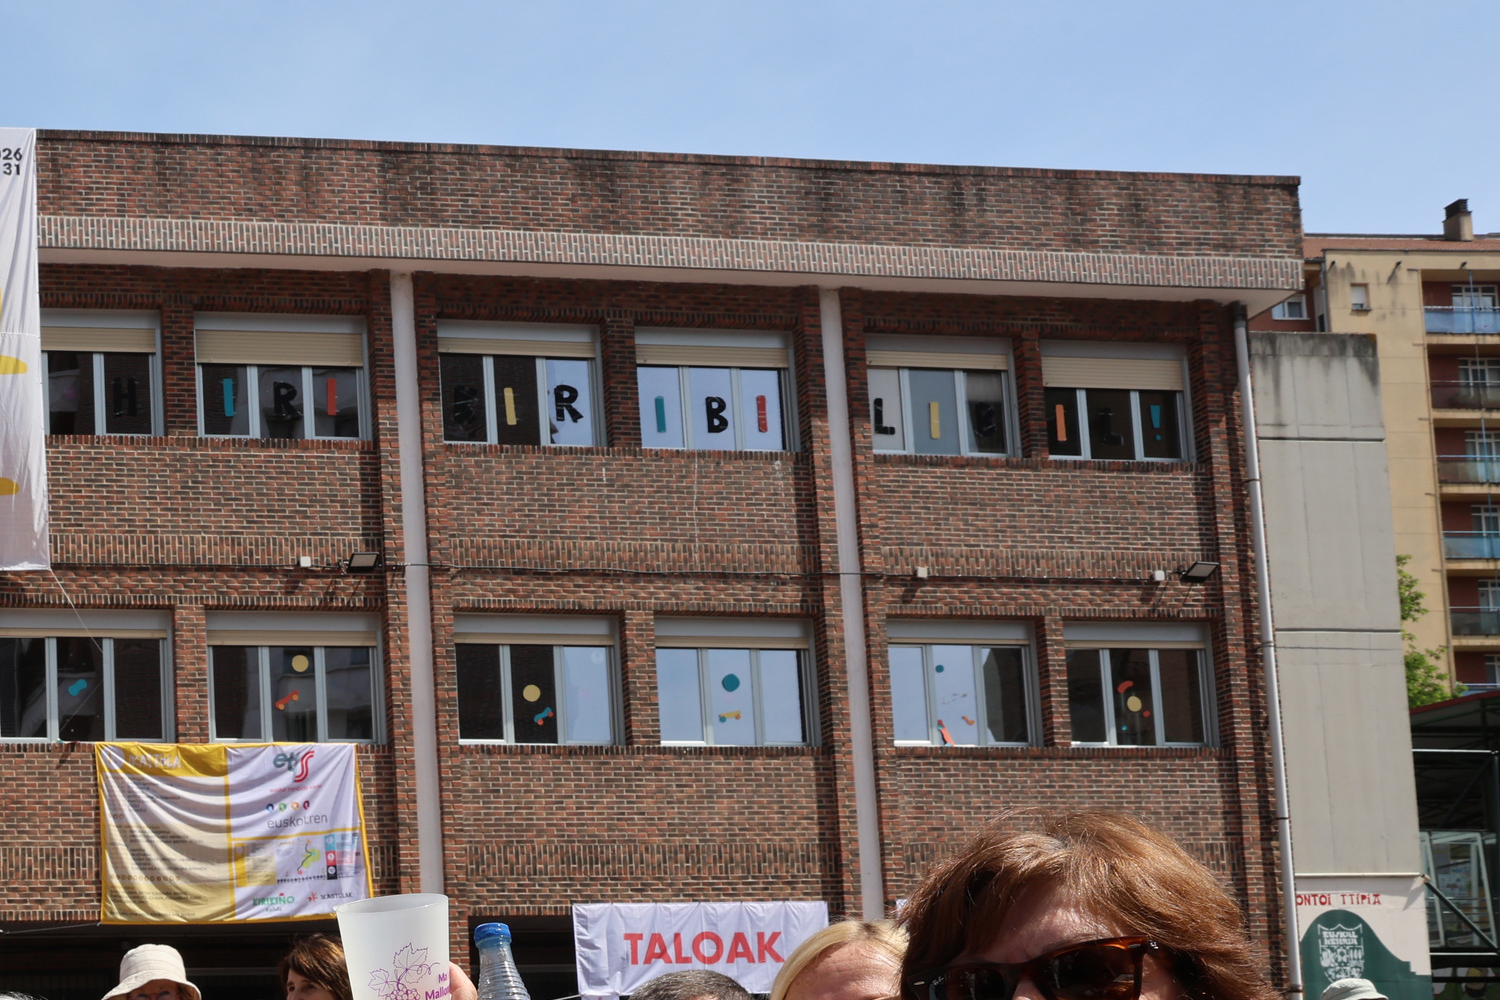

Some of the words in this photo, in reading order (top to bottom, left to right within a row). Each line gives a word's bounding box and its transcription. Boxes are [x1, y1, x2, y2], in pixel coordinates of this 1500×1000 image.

[3, 162, 22, 176] 31
[267, 814, 328, 829] euskotren
[623, 931, 785, 966] TALOAK
